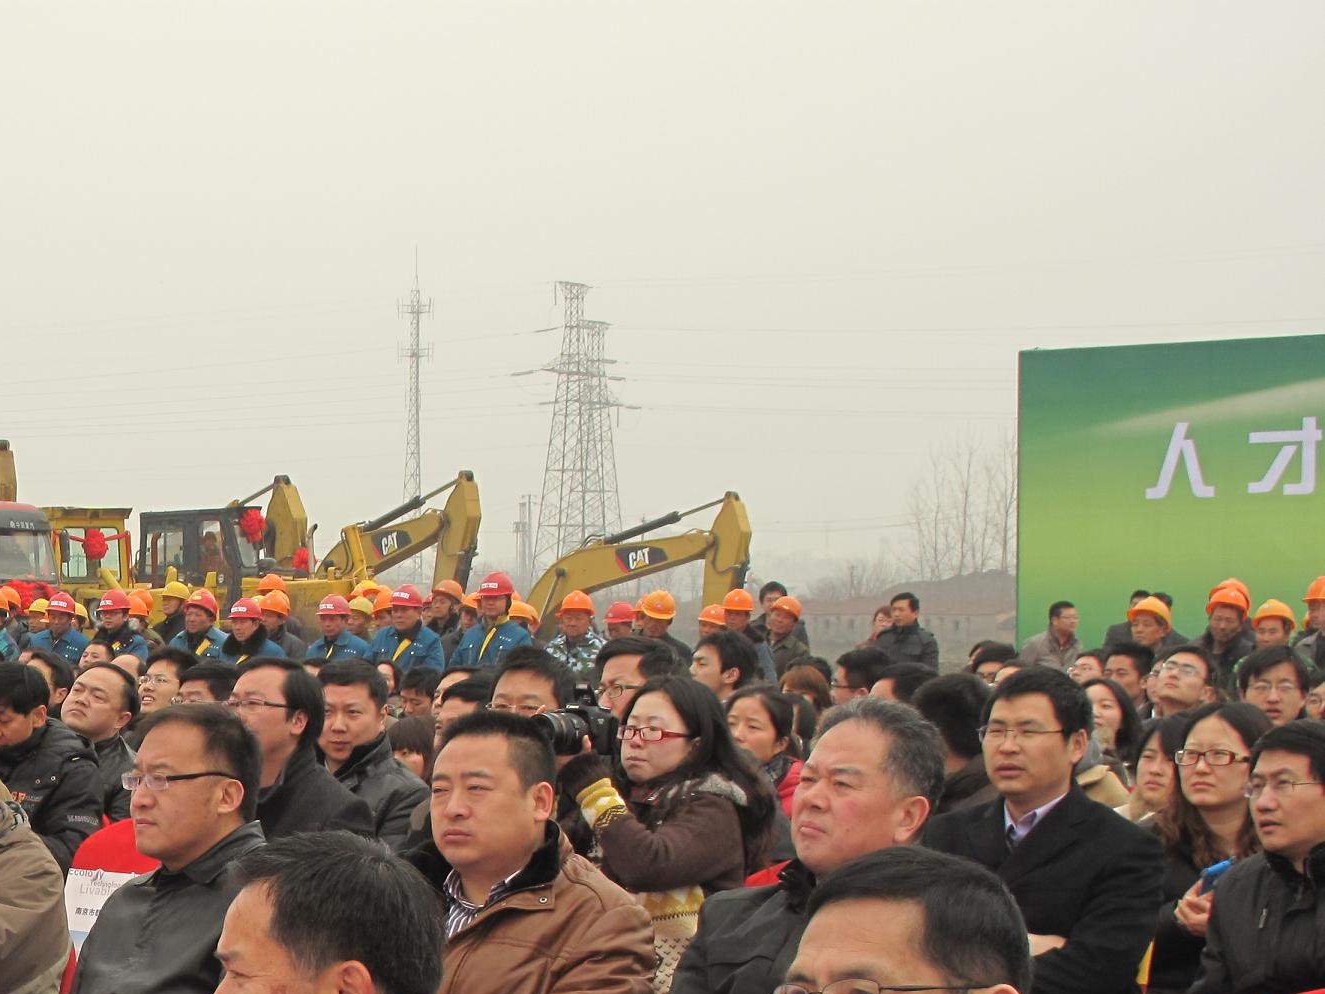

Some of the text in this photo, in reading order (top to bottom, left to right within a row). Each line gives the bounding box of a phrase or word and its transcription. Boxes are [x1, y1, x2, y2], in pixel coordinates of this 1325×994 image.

[1145, 416, 1323, 500] 人才
[381, 530, 398, 556] CAT
[628, 547, 650, 570] CAT
